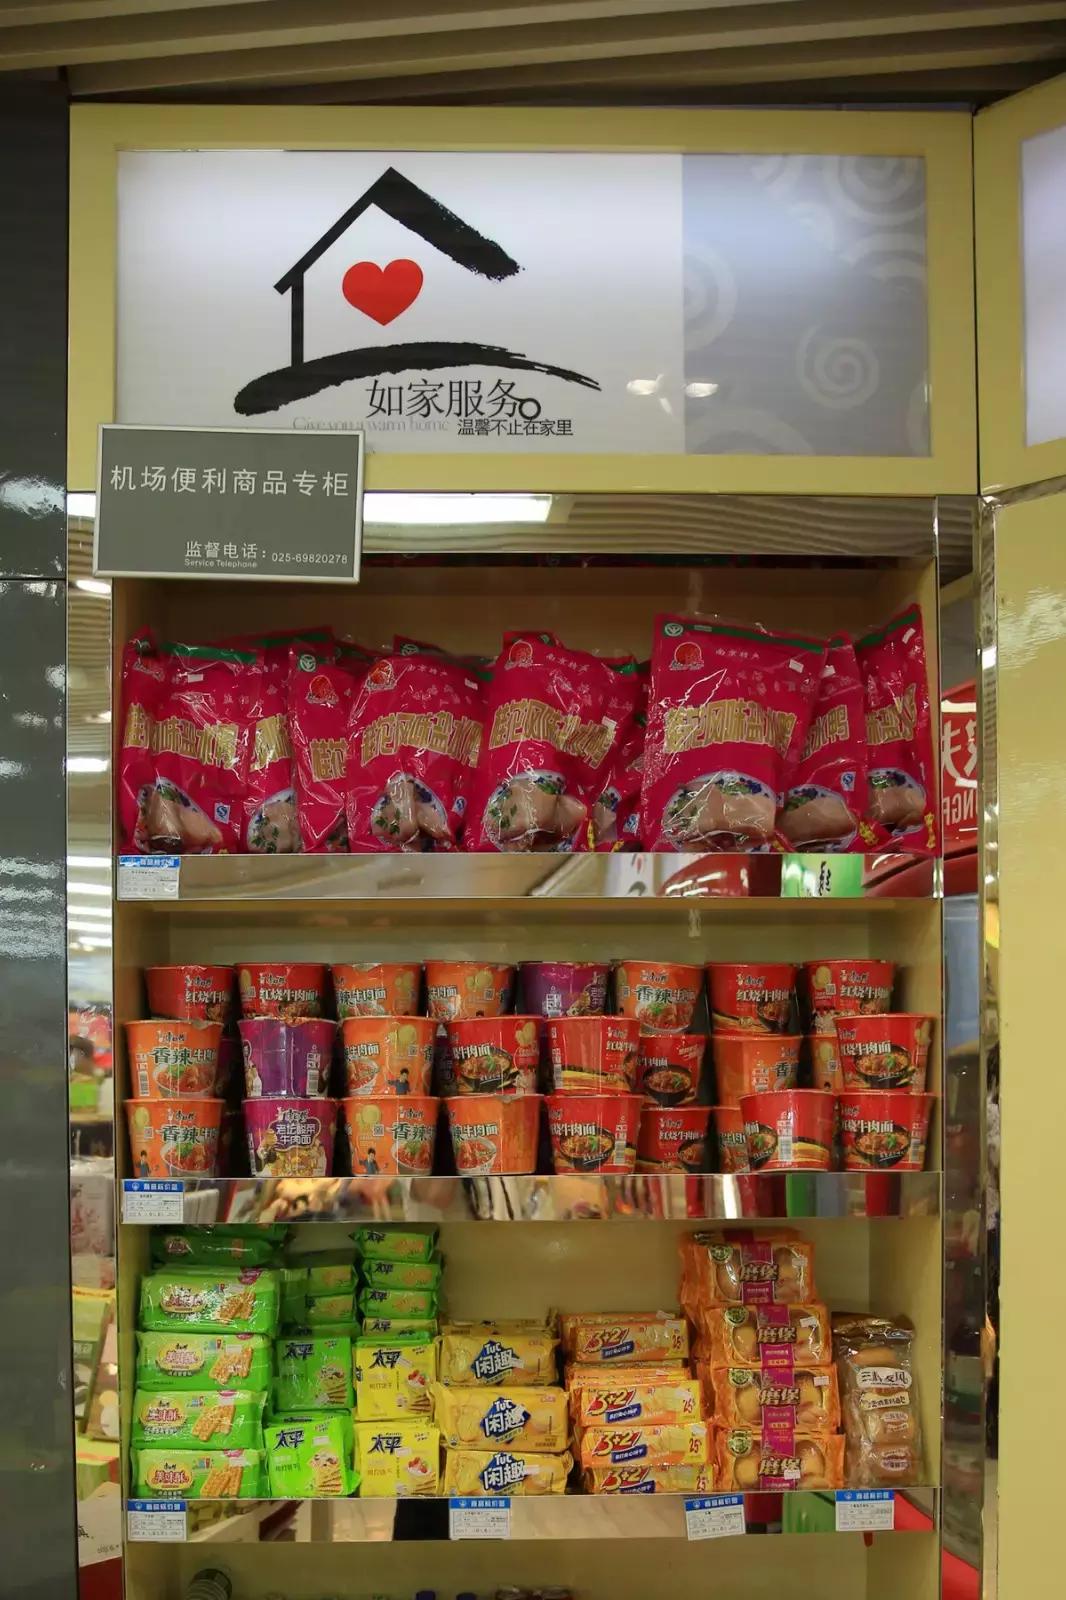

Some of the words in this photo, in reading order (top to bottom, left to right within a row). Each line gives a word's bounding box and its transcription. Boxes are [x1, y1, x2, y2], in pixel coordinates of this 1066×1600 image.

[365, 379, 519, 418] 如家服务
[410, 416, 450, 432] home
[457, 418, 573, 437] 温馨不止在家里
[110, 465, 349, 496] 机场便利商品专柜
[184, 558, 215, 567] Service
[216, 559, 258, 569] Telephone
[272, 552, 348, 565] 025-69820278
[260, 989, 318, 1002] 红烧牛肉面
[345, 1043, 379, 1059] 牛肉面
[275, 1124, 316, 1135] 老坛酸菜
[279, 1135, 312, 1146] 牛肉面
[283, 1342, 314, 1361] 太平
[368, 1349, 402, 1369] 太平
[475, 1349, 514, 1378] 闲趣
[588, 1388, 628, 1416] 3+2
[273, 1430, 305, 1451] 太平
[367, 1433, 403, 1455] 太平
[594, 1431, 633, 1456] 3+2
[484, 1460, 526, 1490] 闲趣
